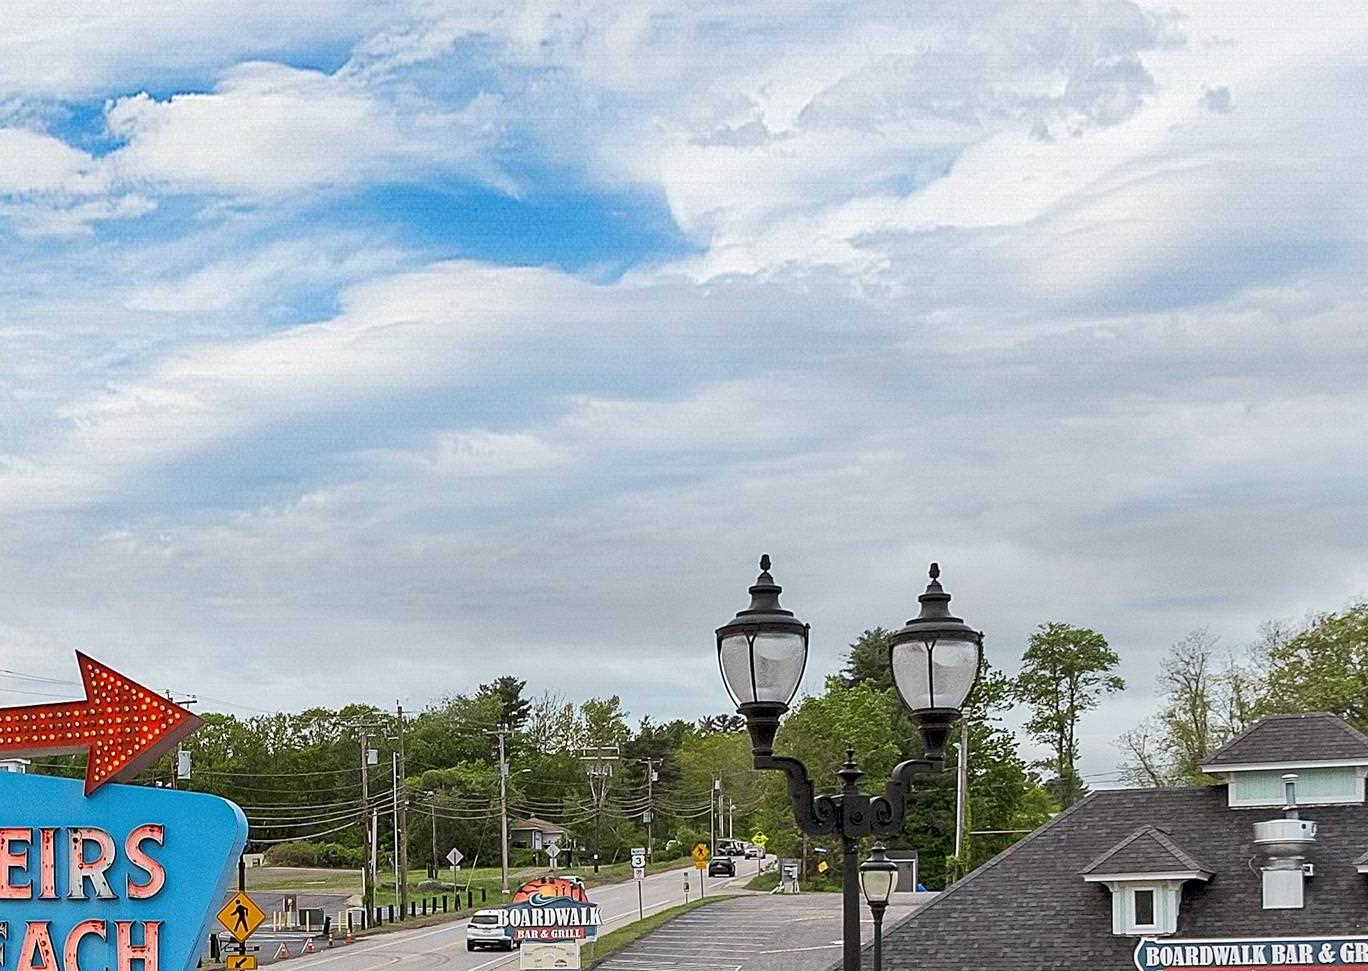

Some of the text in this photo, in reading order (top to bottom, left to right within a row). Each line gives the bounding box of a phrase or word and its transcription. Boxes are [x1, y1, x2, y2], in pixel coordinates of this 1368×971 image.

[635, 857, 642, 865] 3
[497, 907, 602, 928] BOARDWALK
[517, 929, 581, 939] BAR & GRILL
[1145, 944, 1268, 967] BOARDWALK
[1271, 942, 1314, 965] BAR
[1317, 942, 1336, 963] &
